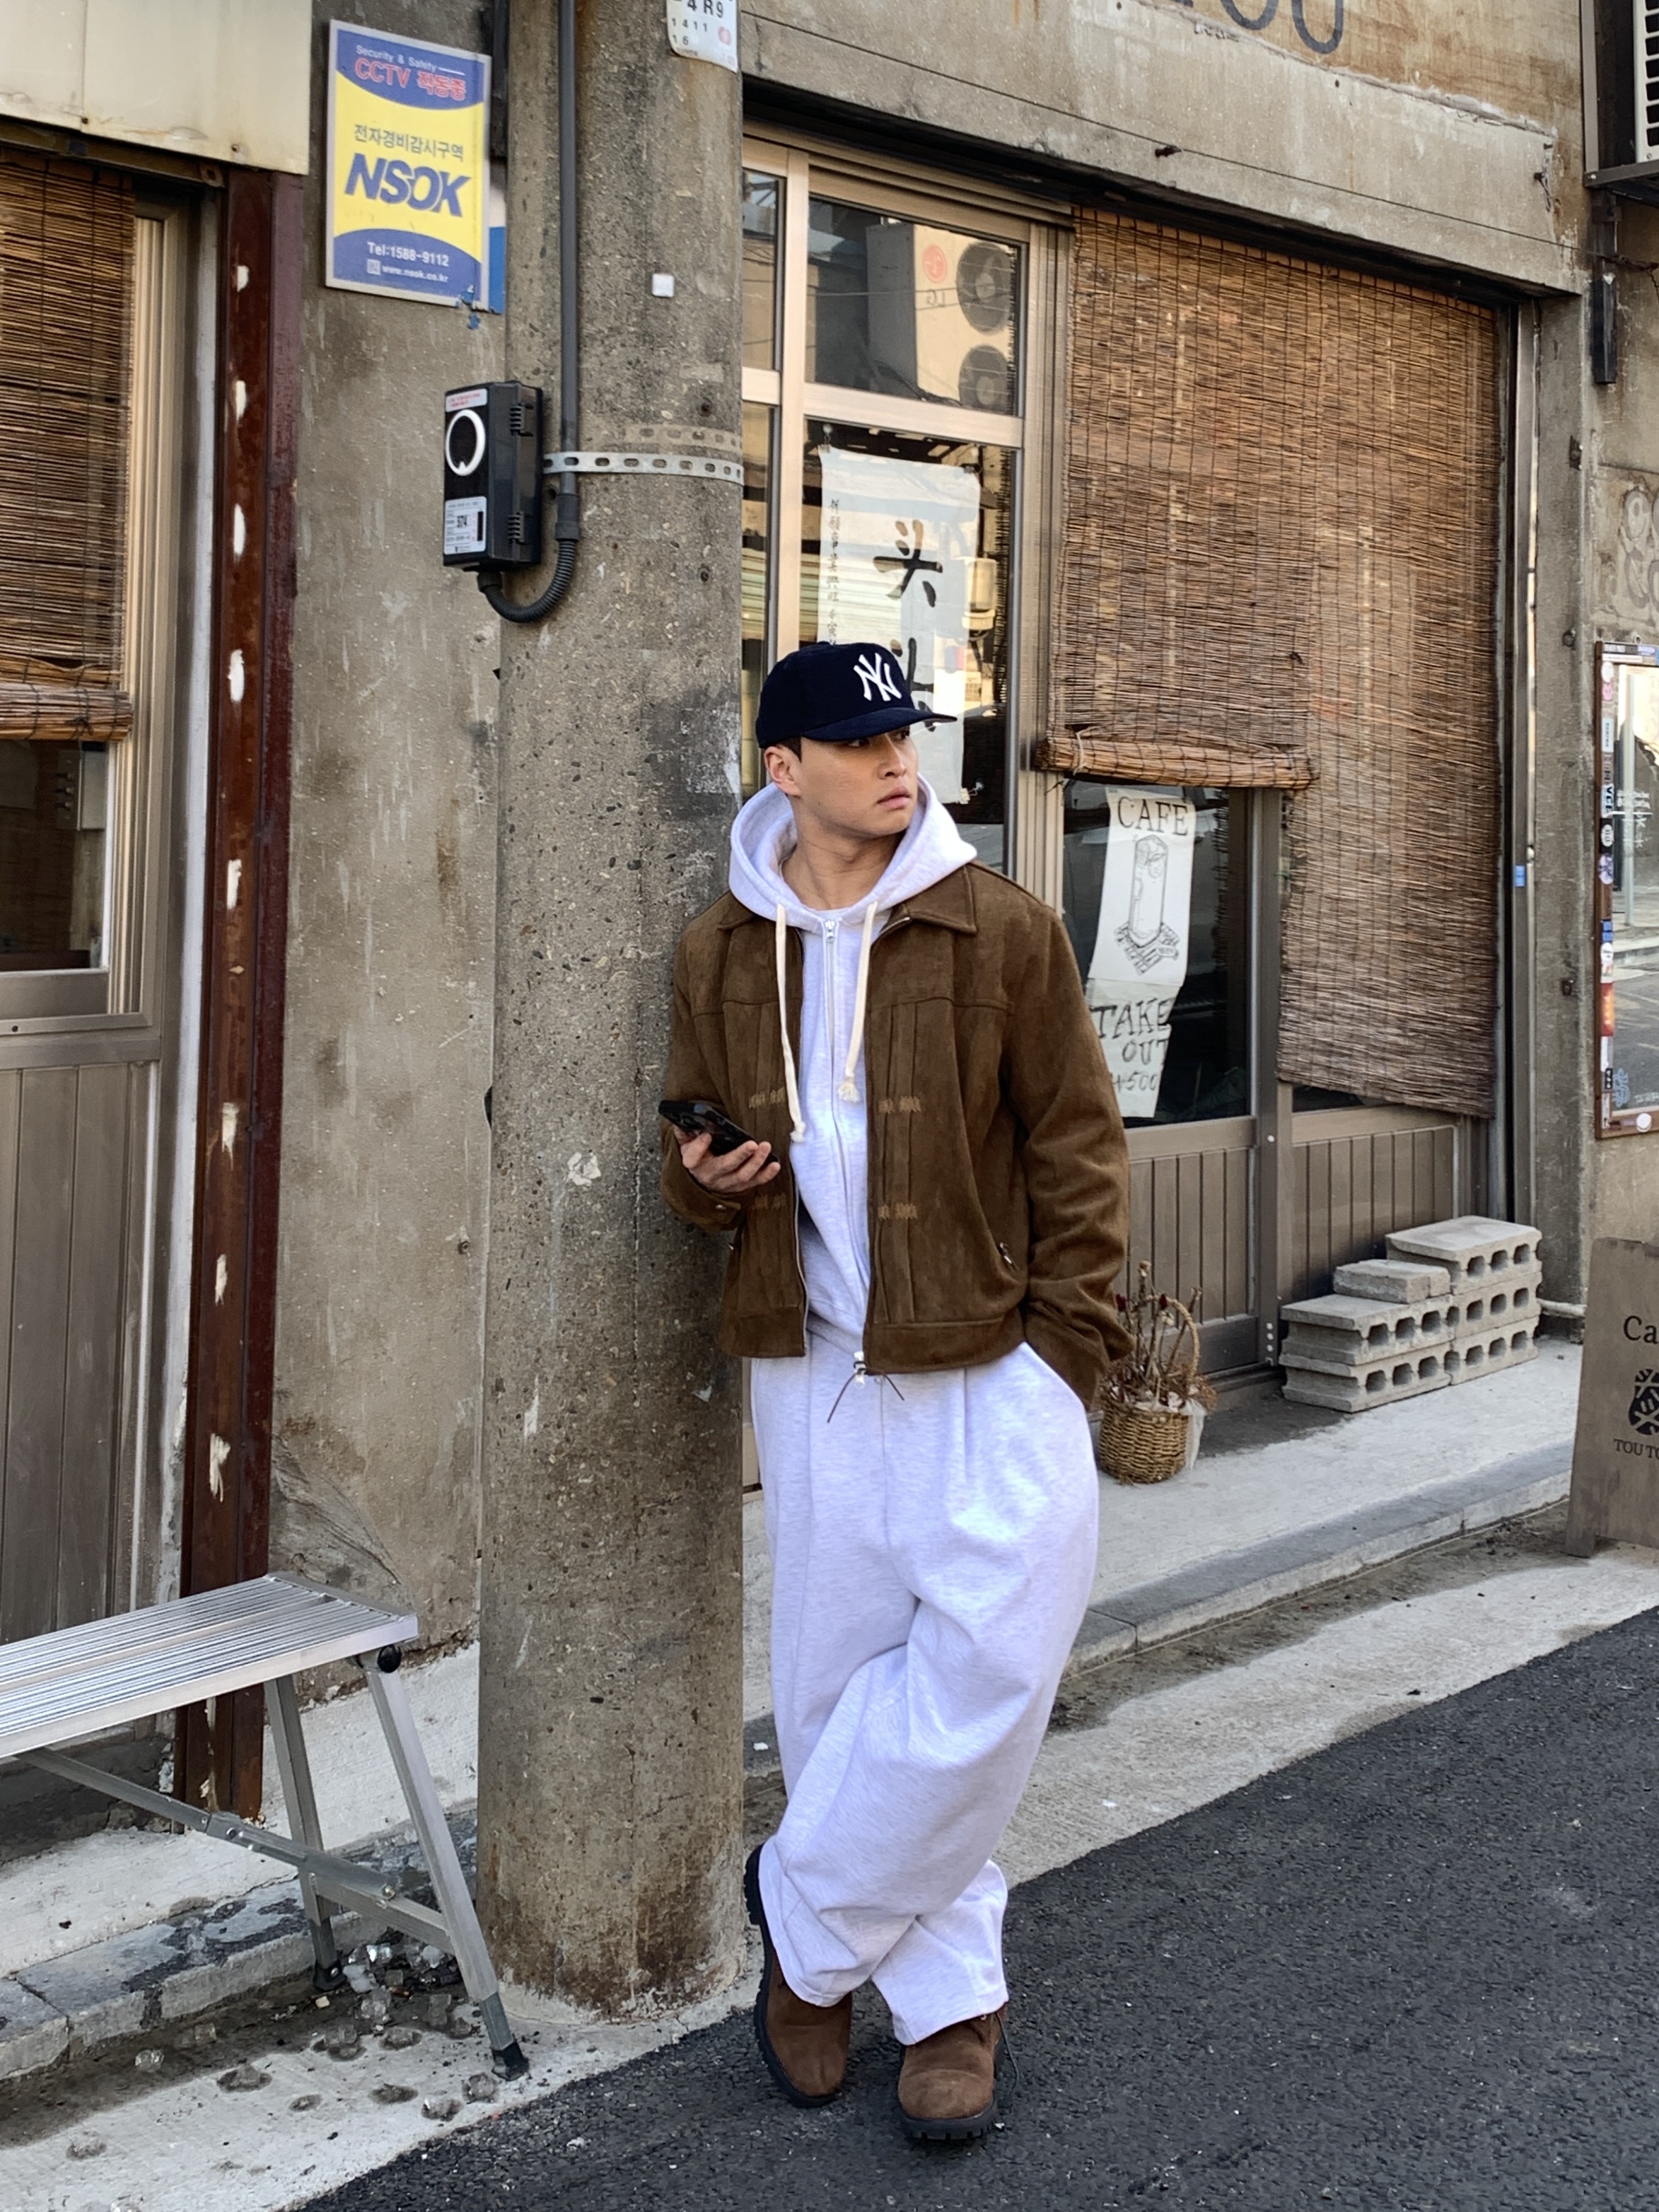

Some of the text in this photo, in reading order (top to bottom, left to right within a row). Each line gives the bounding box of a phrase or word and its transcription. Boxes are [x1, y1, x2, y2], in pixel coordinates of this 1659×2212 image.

[355, 57, 411, 88] CCTV
[356, 45, 438, 73] Security & Safety
[354, 124, 464, 162] 전자경비감시구역
[344, 152, 472, 218] NSOK
[366, 241, 449, 267] Tel:1588-9112
[382, 265, 449, 282] www.nsok.co.kr
[853, 652, 902, 702] NY
[1117, 796, 1188, 836] CAFE
[1088, 997, 1176, 1040] TAKE
[1624, 1315, 1658, 1344] Ca
[1614, 1438, 1643, 1456] TOU
